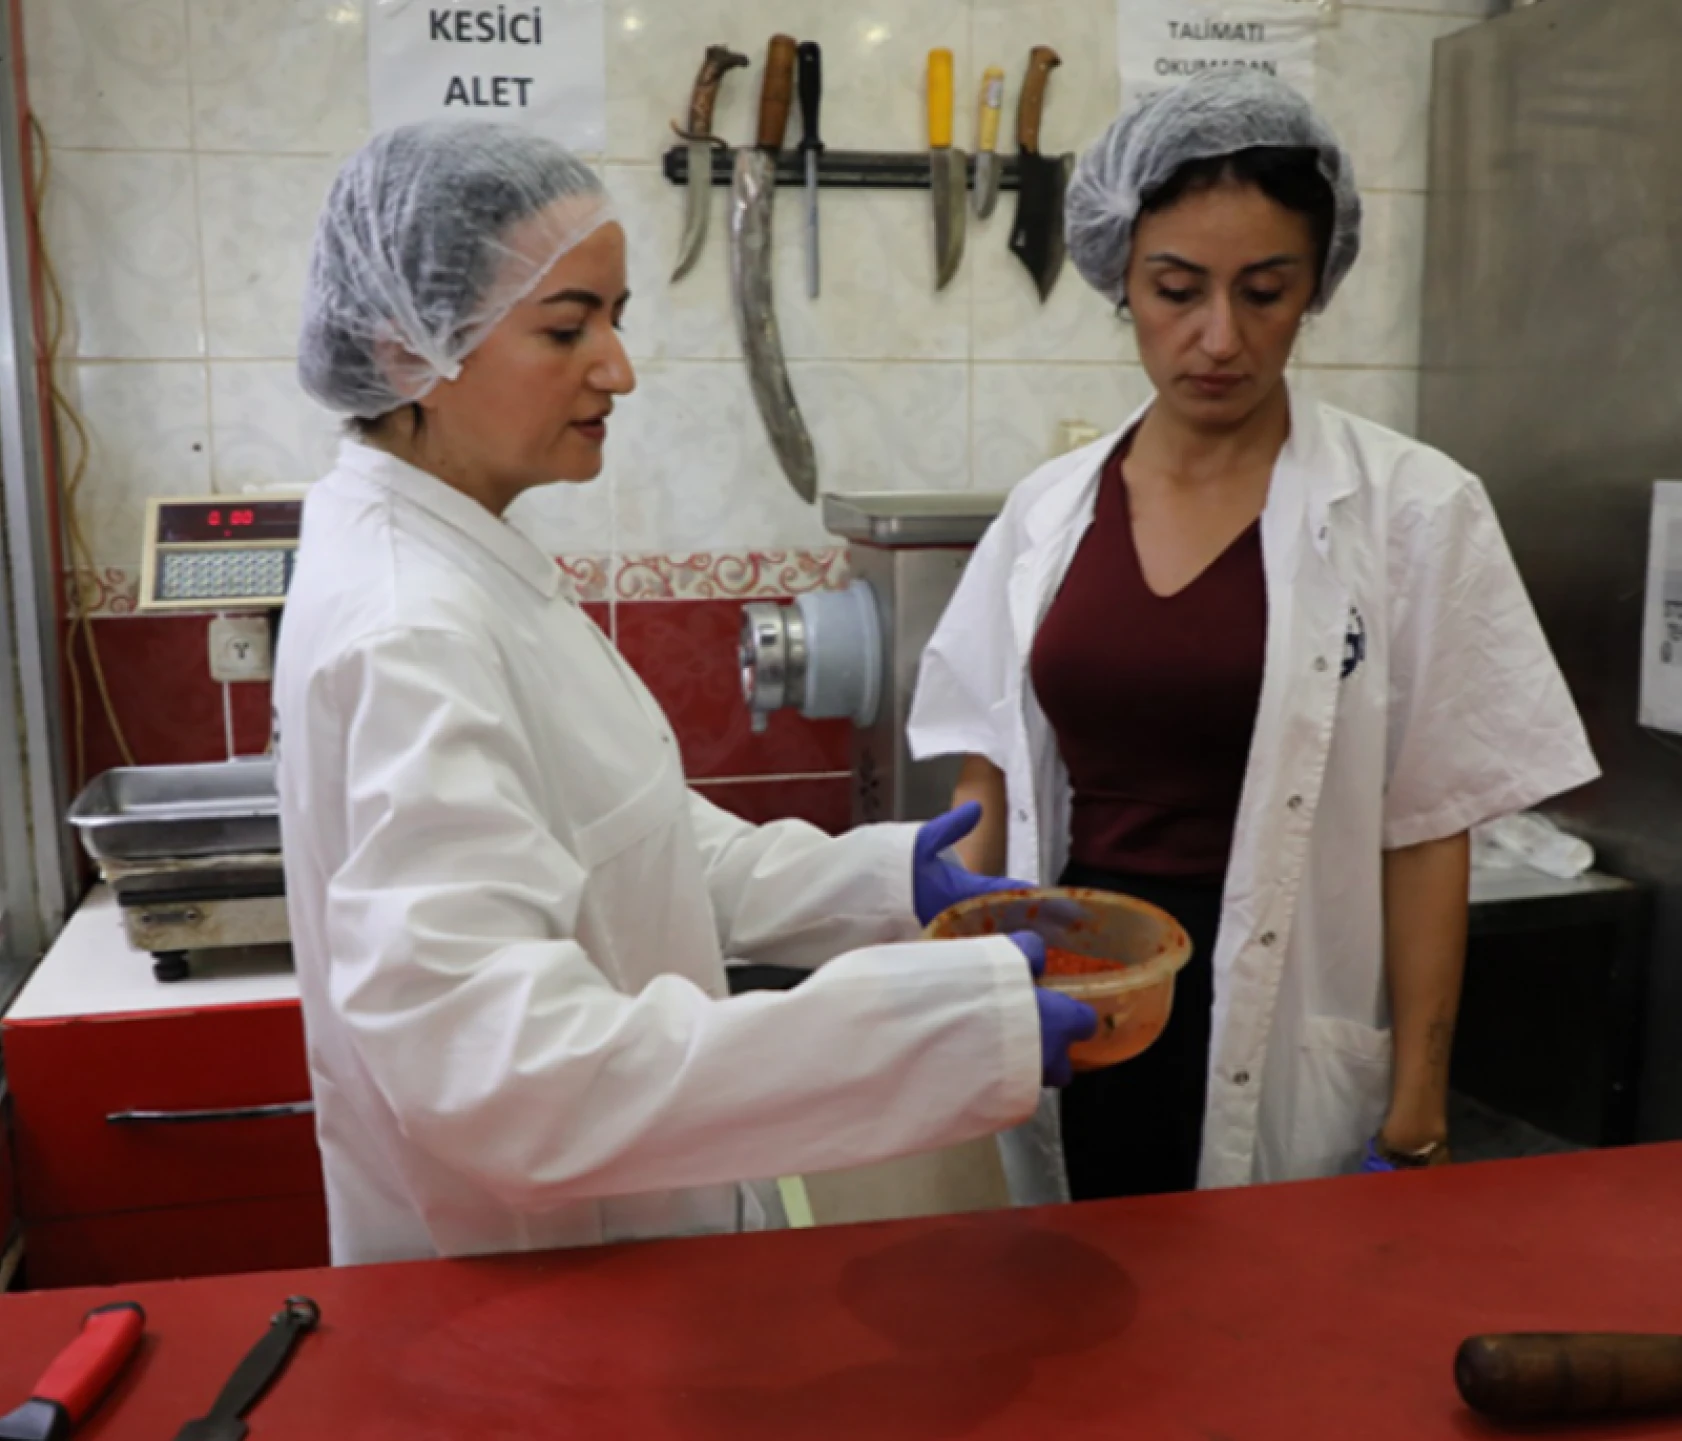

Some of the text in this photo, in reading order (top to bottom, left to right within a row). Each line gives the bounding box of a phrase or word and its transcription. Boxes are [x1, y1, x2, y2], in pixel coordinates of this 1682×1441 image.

[429, 4, 542, 45] KESİCİ
[1167, 17, 1265, 41] TALİMATI
[443, 75, 534, 107] ALET
